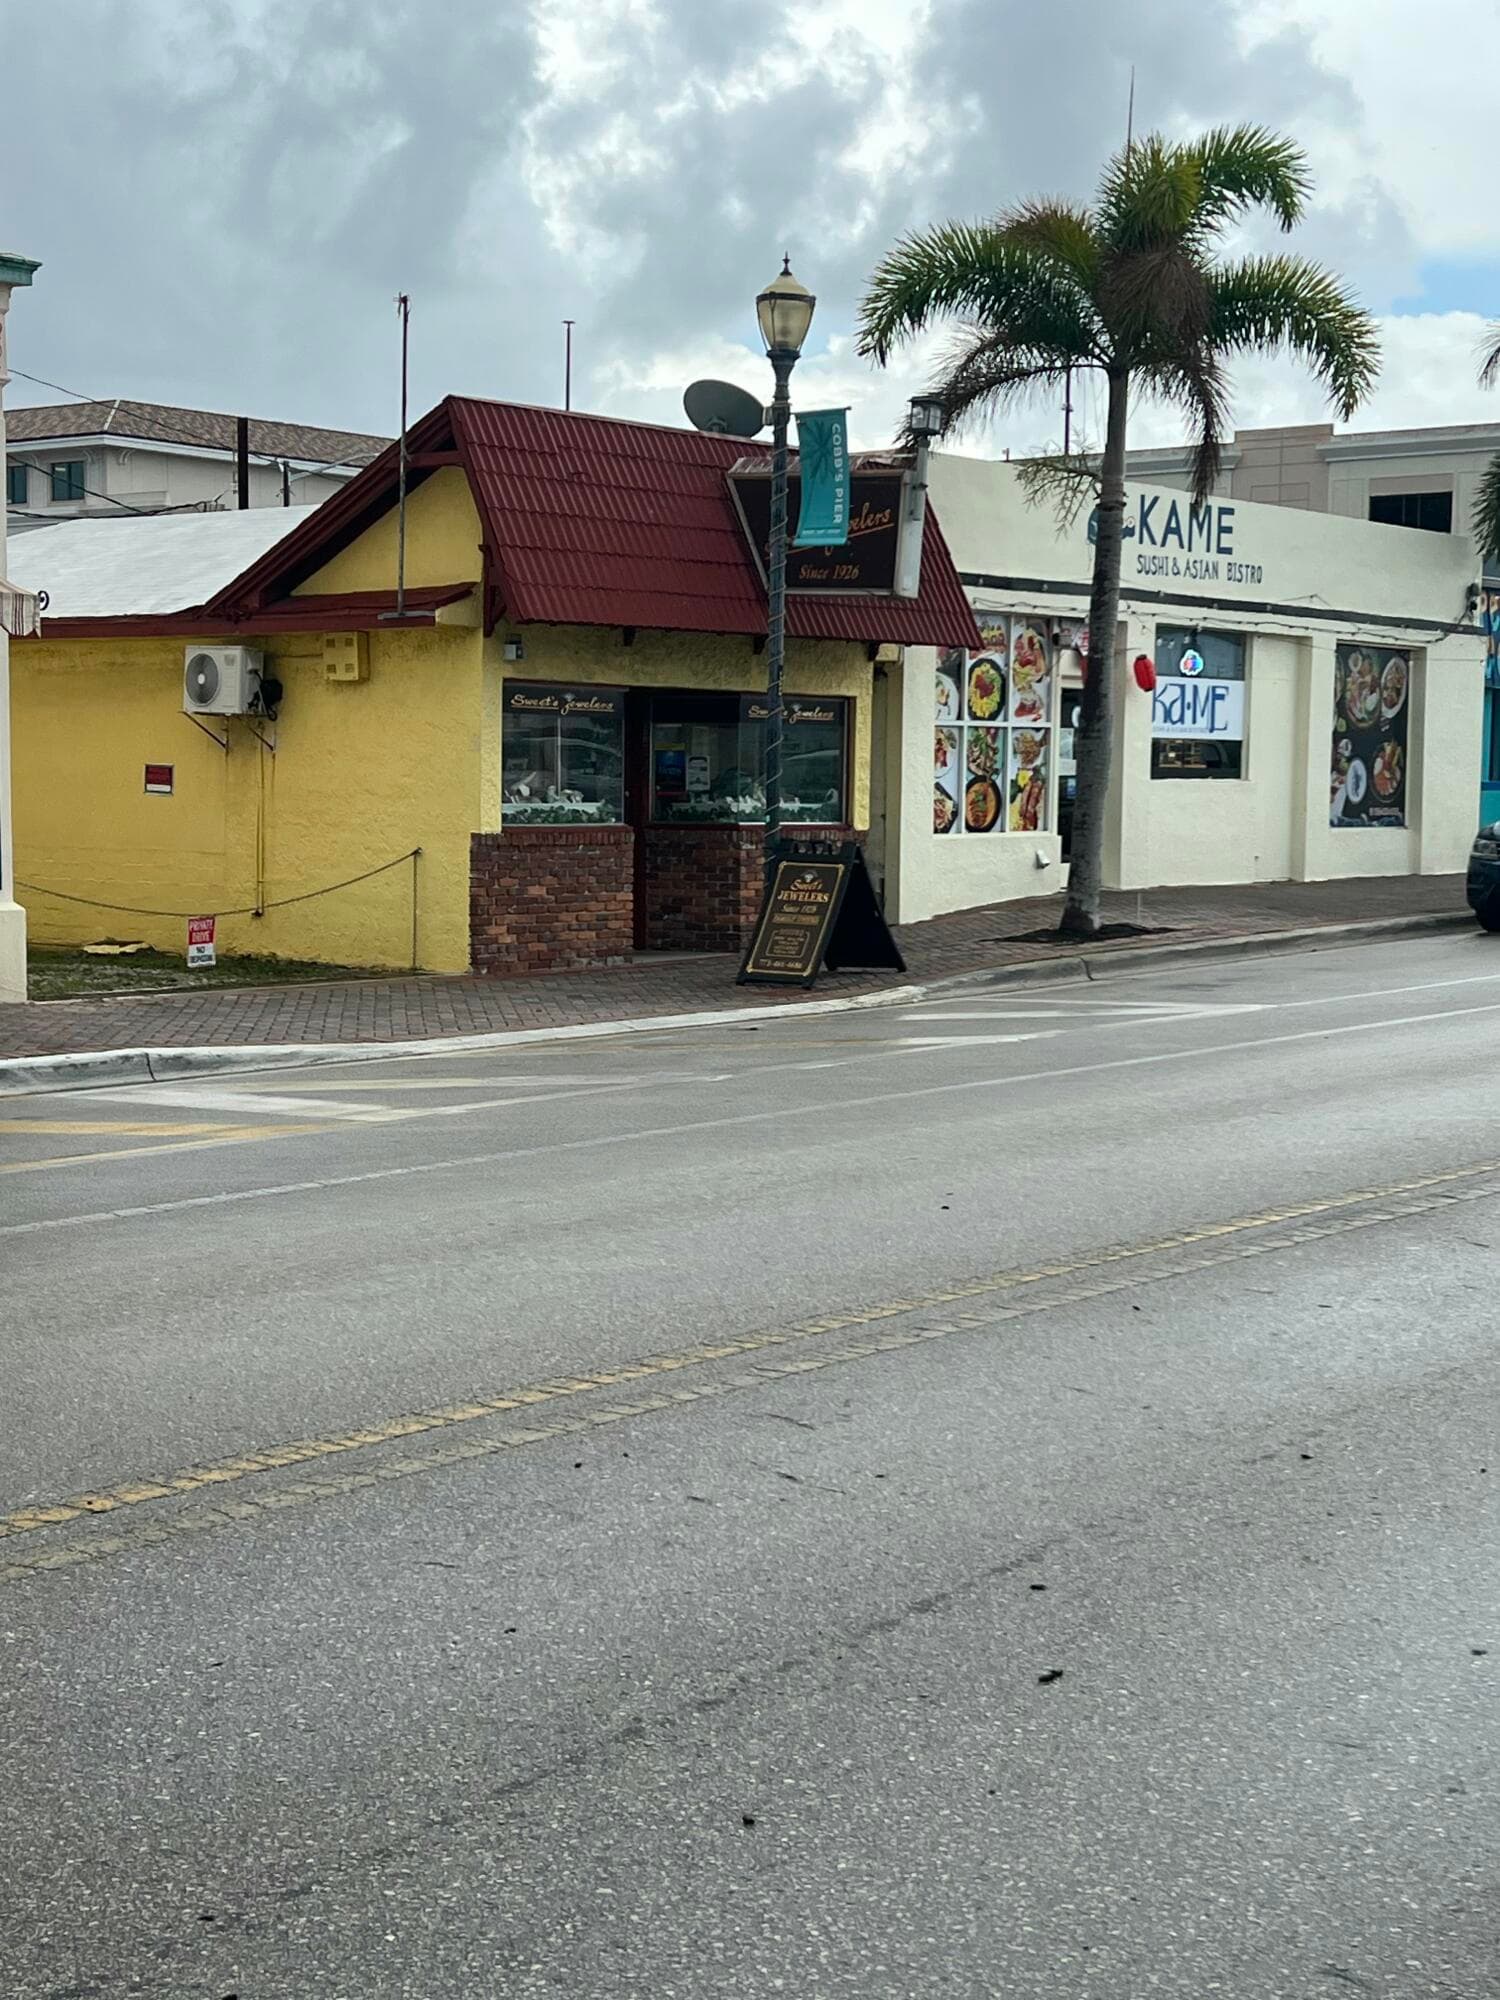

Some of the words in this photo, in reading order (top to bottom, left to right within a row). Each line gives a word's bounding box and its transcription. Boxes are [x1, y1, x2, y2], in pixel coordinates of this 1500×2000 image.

[832, 423, 844, 482] COBB'S
[833, 487, 844, 524] PIER
[1138, 494, 1235, 555] KAME
[799, 565, 829, 580] Since
[832, 564, 860, 580] 1926
[1136, 554, 1169, 577] SUSHI
[1171, 557, 1180, 576] &
[1183, 559, 1219, 580] ASIAN
[1227, 562, 1263, 584] BISTRO
[510, 694, 559, 709] Sweet's
[777, 890, 830, 902] JEWELERS
